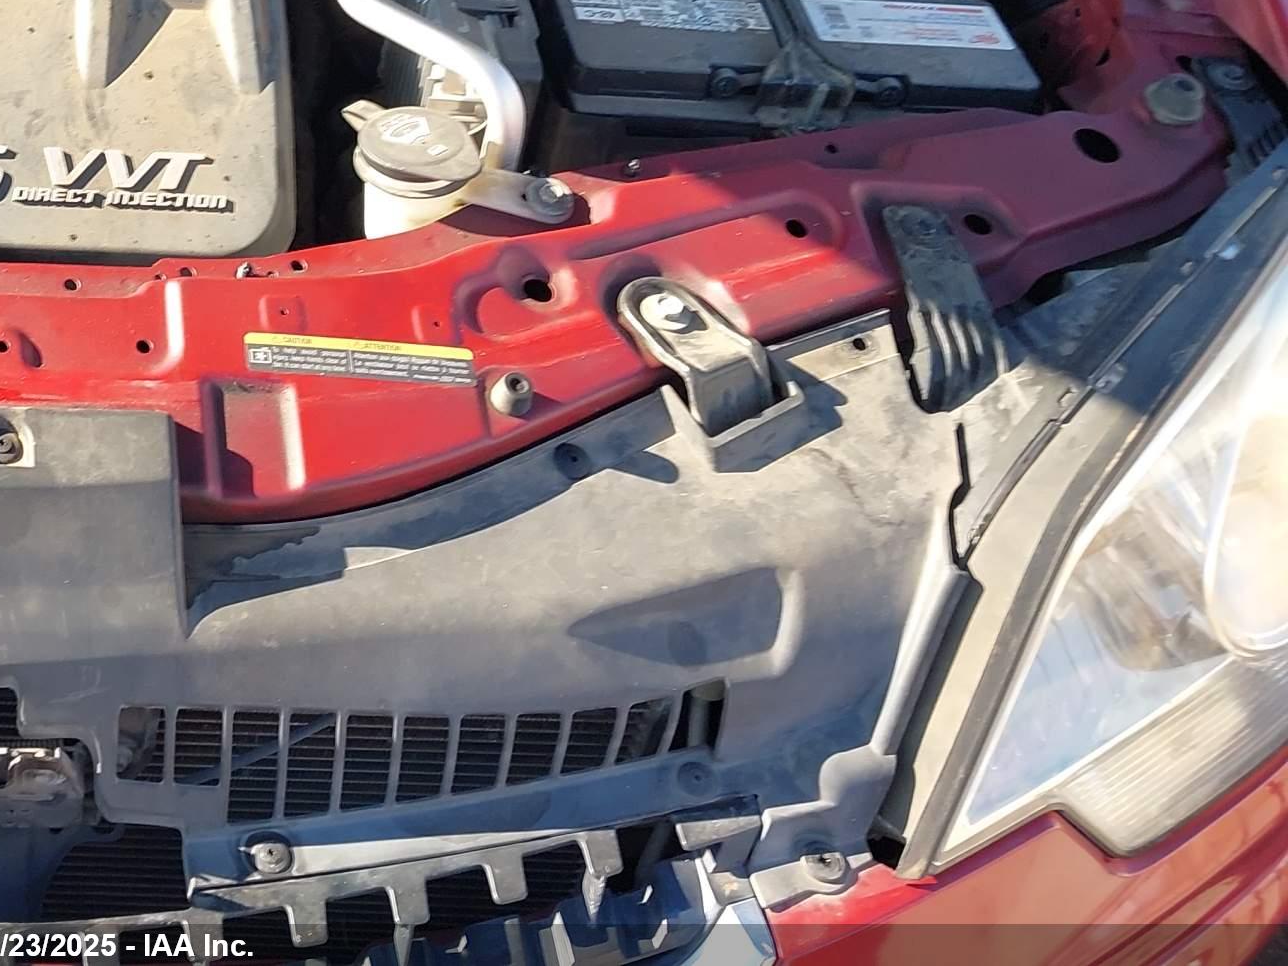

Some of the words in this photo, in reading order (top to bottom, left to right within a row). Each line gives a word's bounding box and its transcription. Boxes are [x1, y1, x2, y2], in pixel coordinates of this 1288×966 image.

[43, 147, 214, 192] VVT
[12, 185, 100, 205] DIRECT
[105, 190, 232, 212] INJECTION
